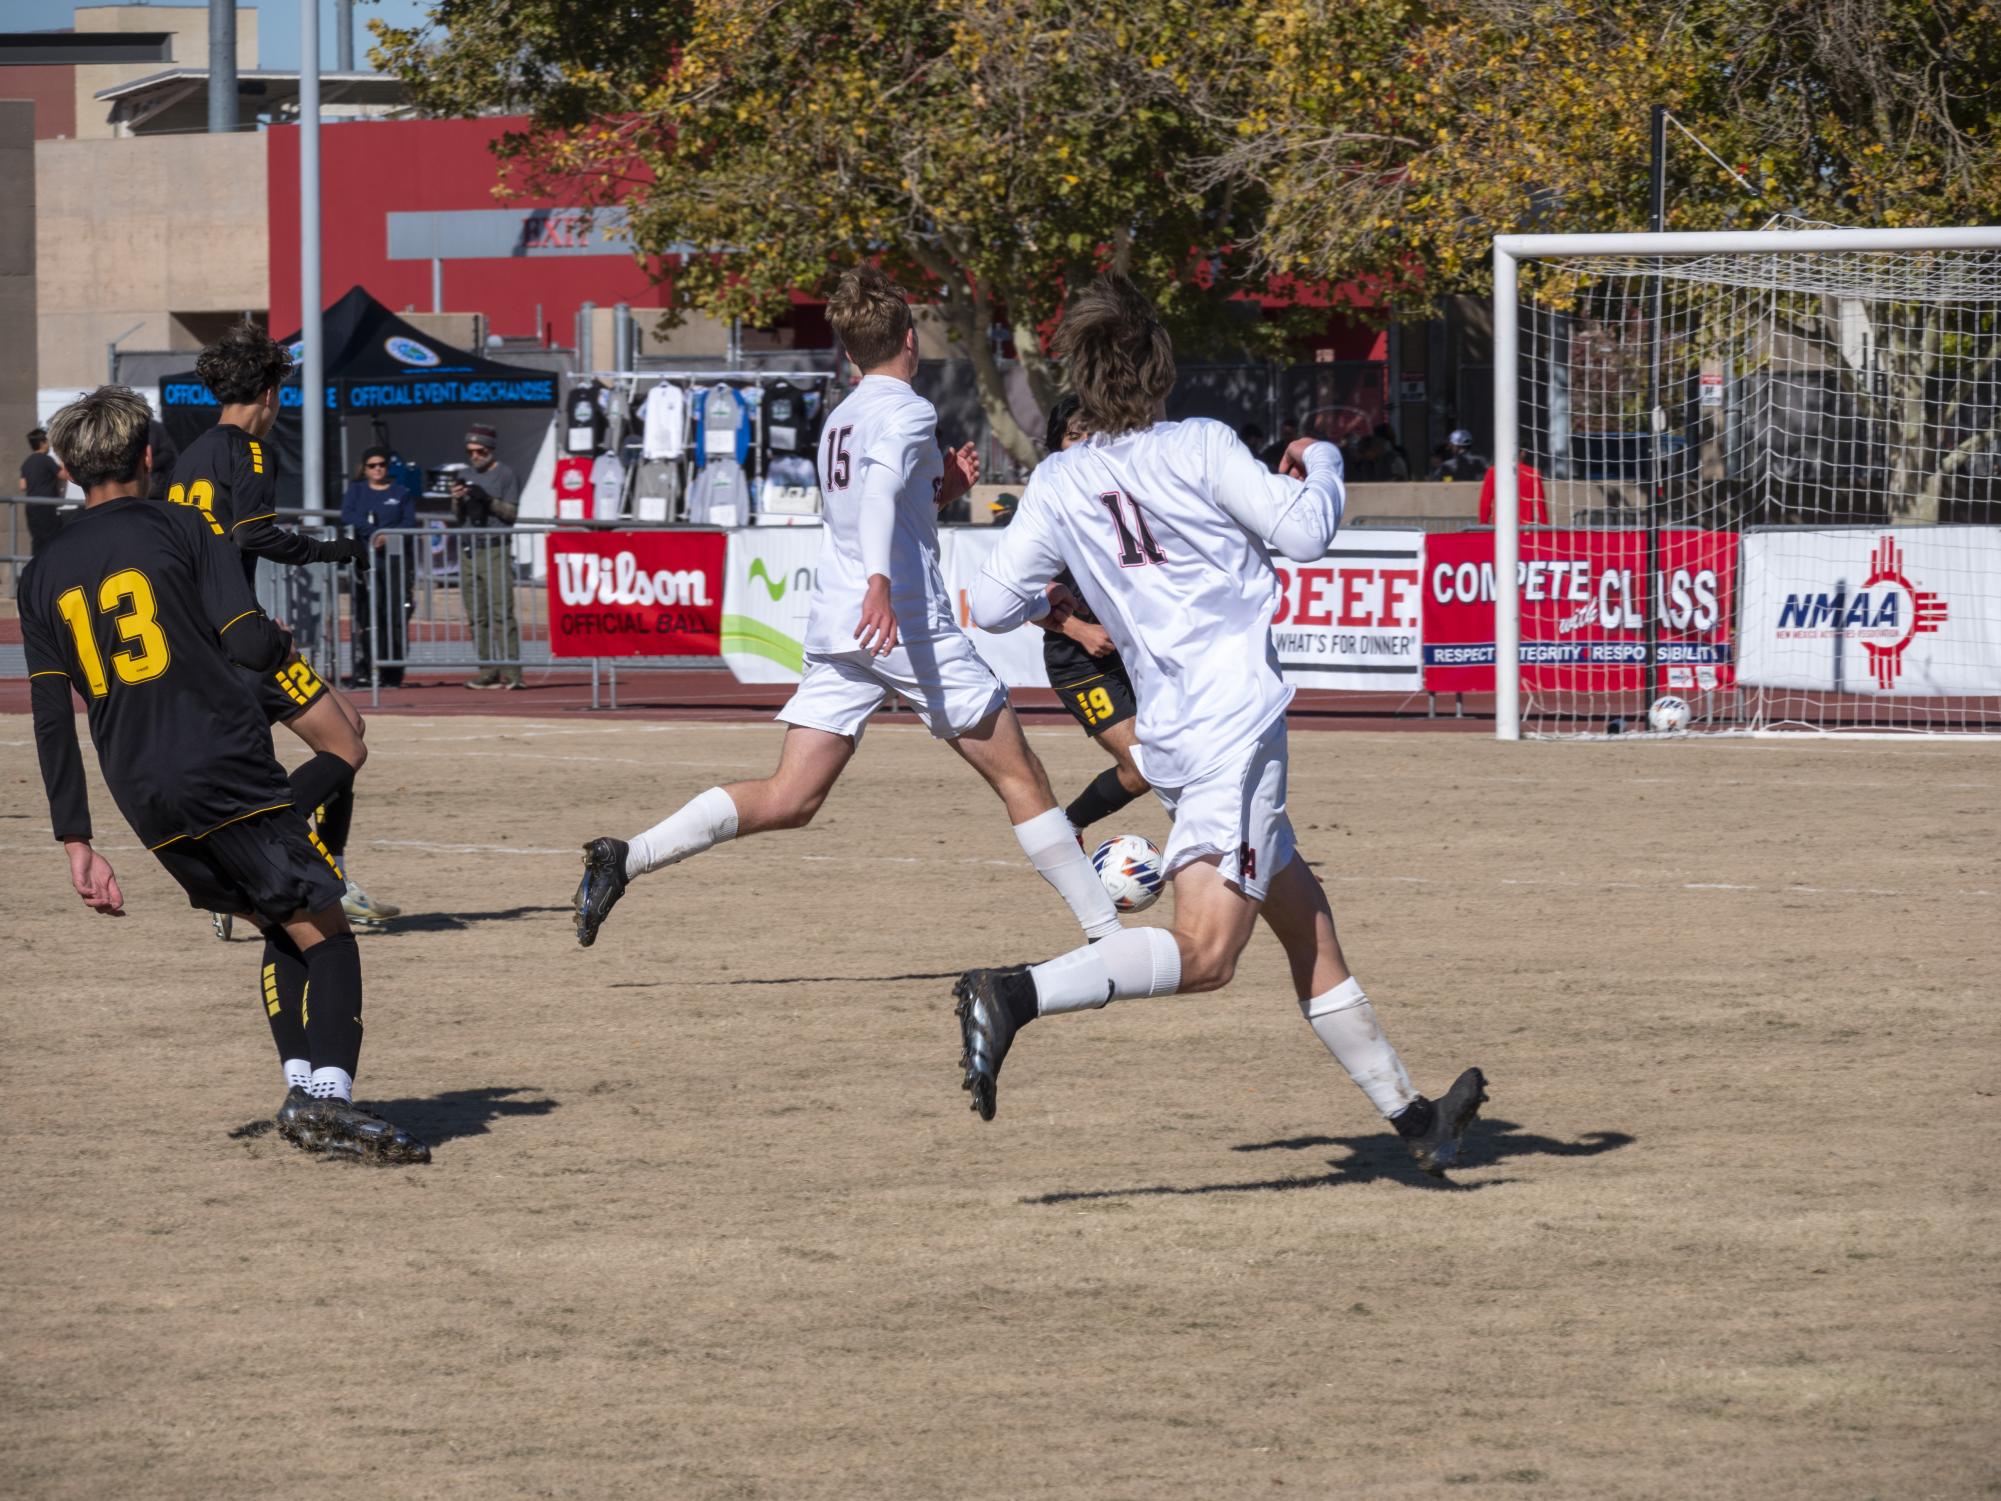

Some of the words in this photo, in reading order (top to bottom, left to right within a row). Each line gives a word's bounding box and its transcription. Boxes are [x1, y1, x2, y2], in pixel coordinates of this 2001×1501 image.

[351, 384, 412, 407] OFFICIAL
[413, 381, 459, 404] EVENT
[460, 380, 553, 402] MERCHANDISE
[827, 424, 854, 492] 15
[1099, 490, 1168, 568] 11
[553, 551, 714, 607] Wilson
[560, 613, 651, 635] OFFICIAL
[656, 613, 717, 635] BALL
[1777, 592, 1900, 628] NMAA
[57, 567, 171, 699] 13
[1276, 633, 1327, 653] WHAT'S
[1331, 635, 1356, 654] FOR
[1434, 647, 1496, 662] RESPECT
[1518, 646, 1582, 662] TEGRITY
[1592, 646, 1718, 661] RESPOSIBILITY
[1088, 686, 1115, 719] 9
